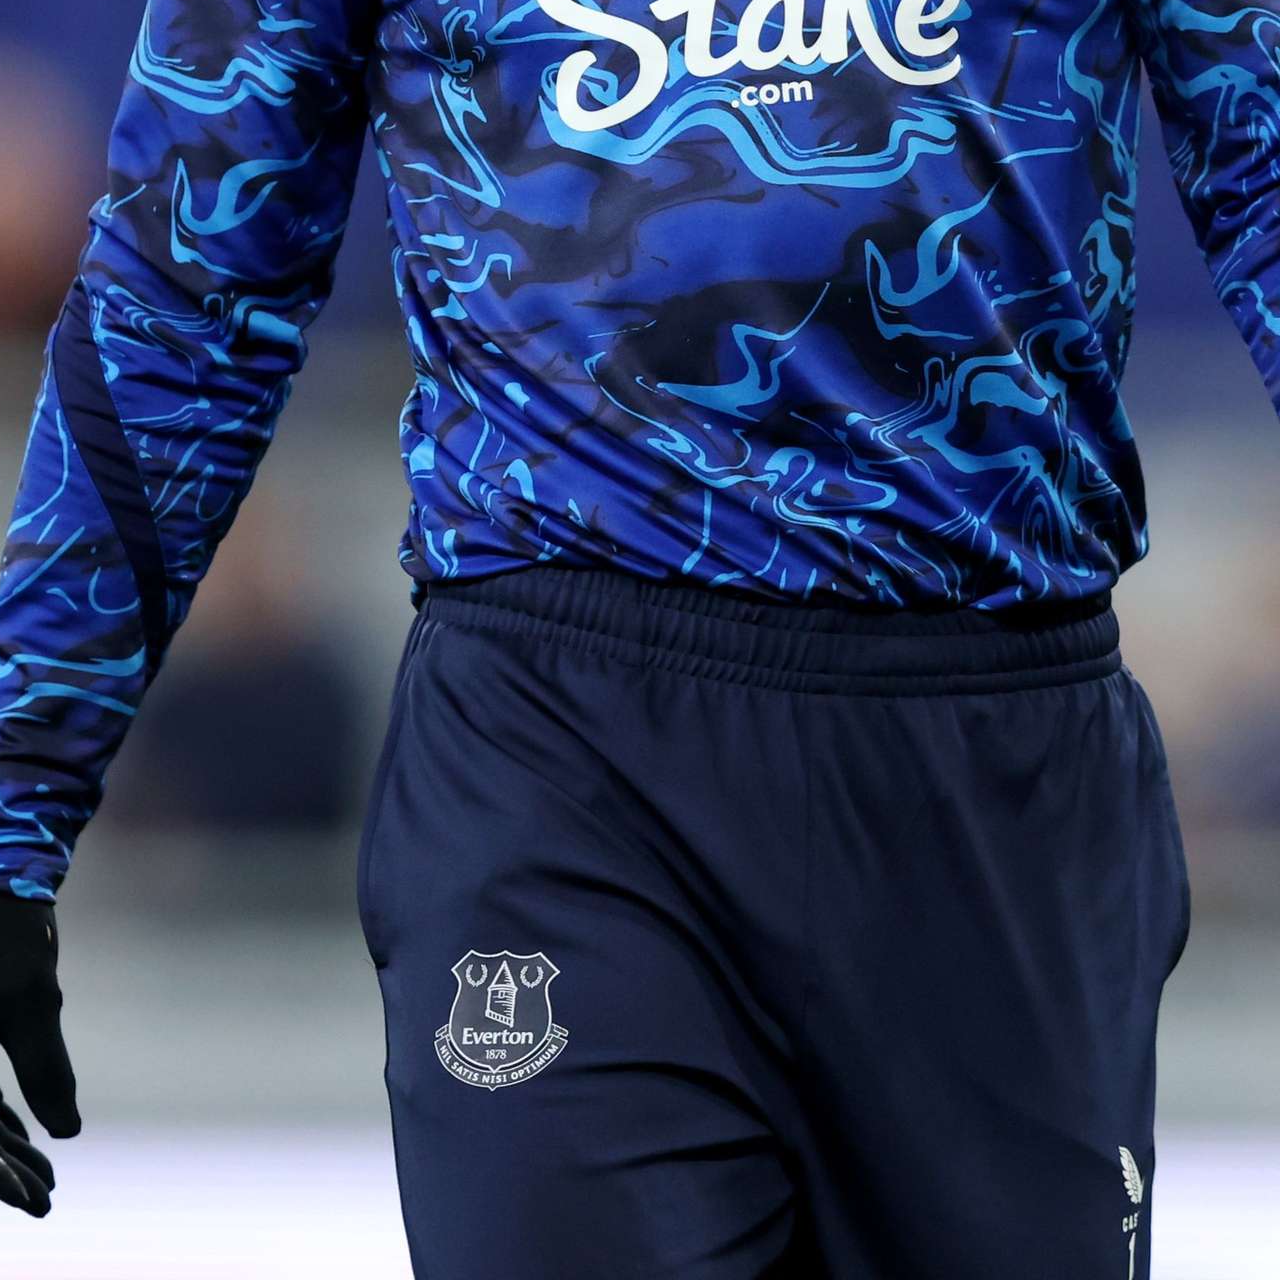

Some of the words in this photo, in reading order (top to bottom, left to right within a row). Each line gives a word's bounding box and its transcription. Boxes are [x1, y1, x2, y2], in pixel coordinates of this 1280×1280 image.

[730, 76, 814, 109] .com
[462, 1027, 534, 1045] Everton
[439, 1045, 452, 1065] NIL
[451, 1062, 479, 1083] SATIS
[481, 1075, 508, 1084] NISI
[510, 1044, 559, 1081] OPTIMUM
[485, 1049, 507, 1060] 1878
